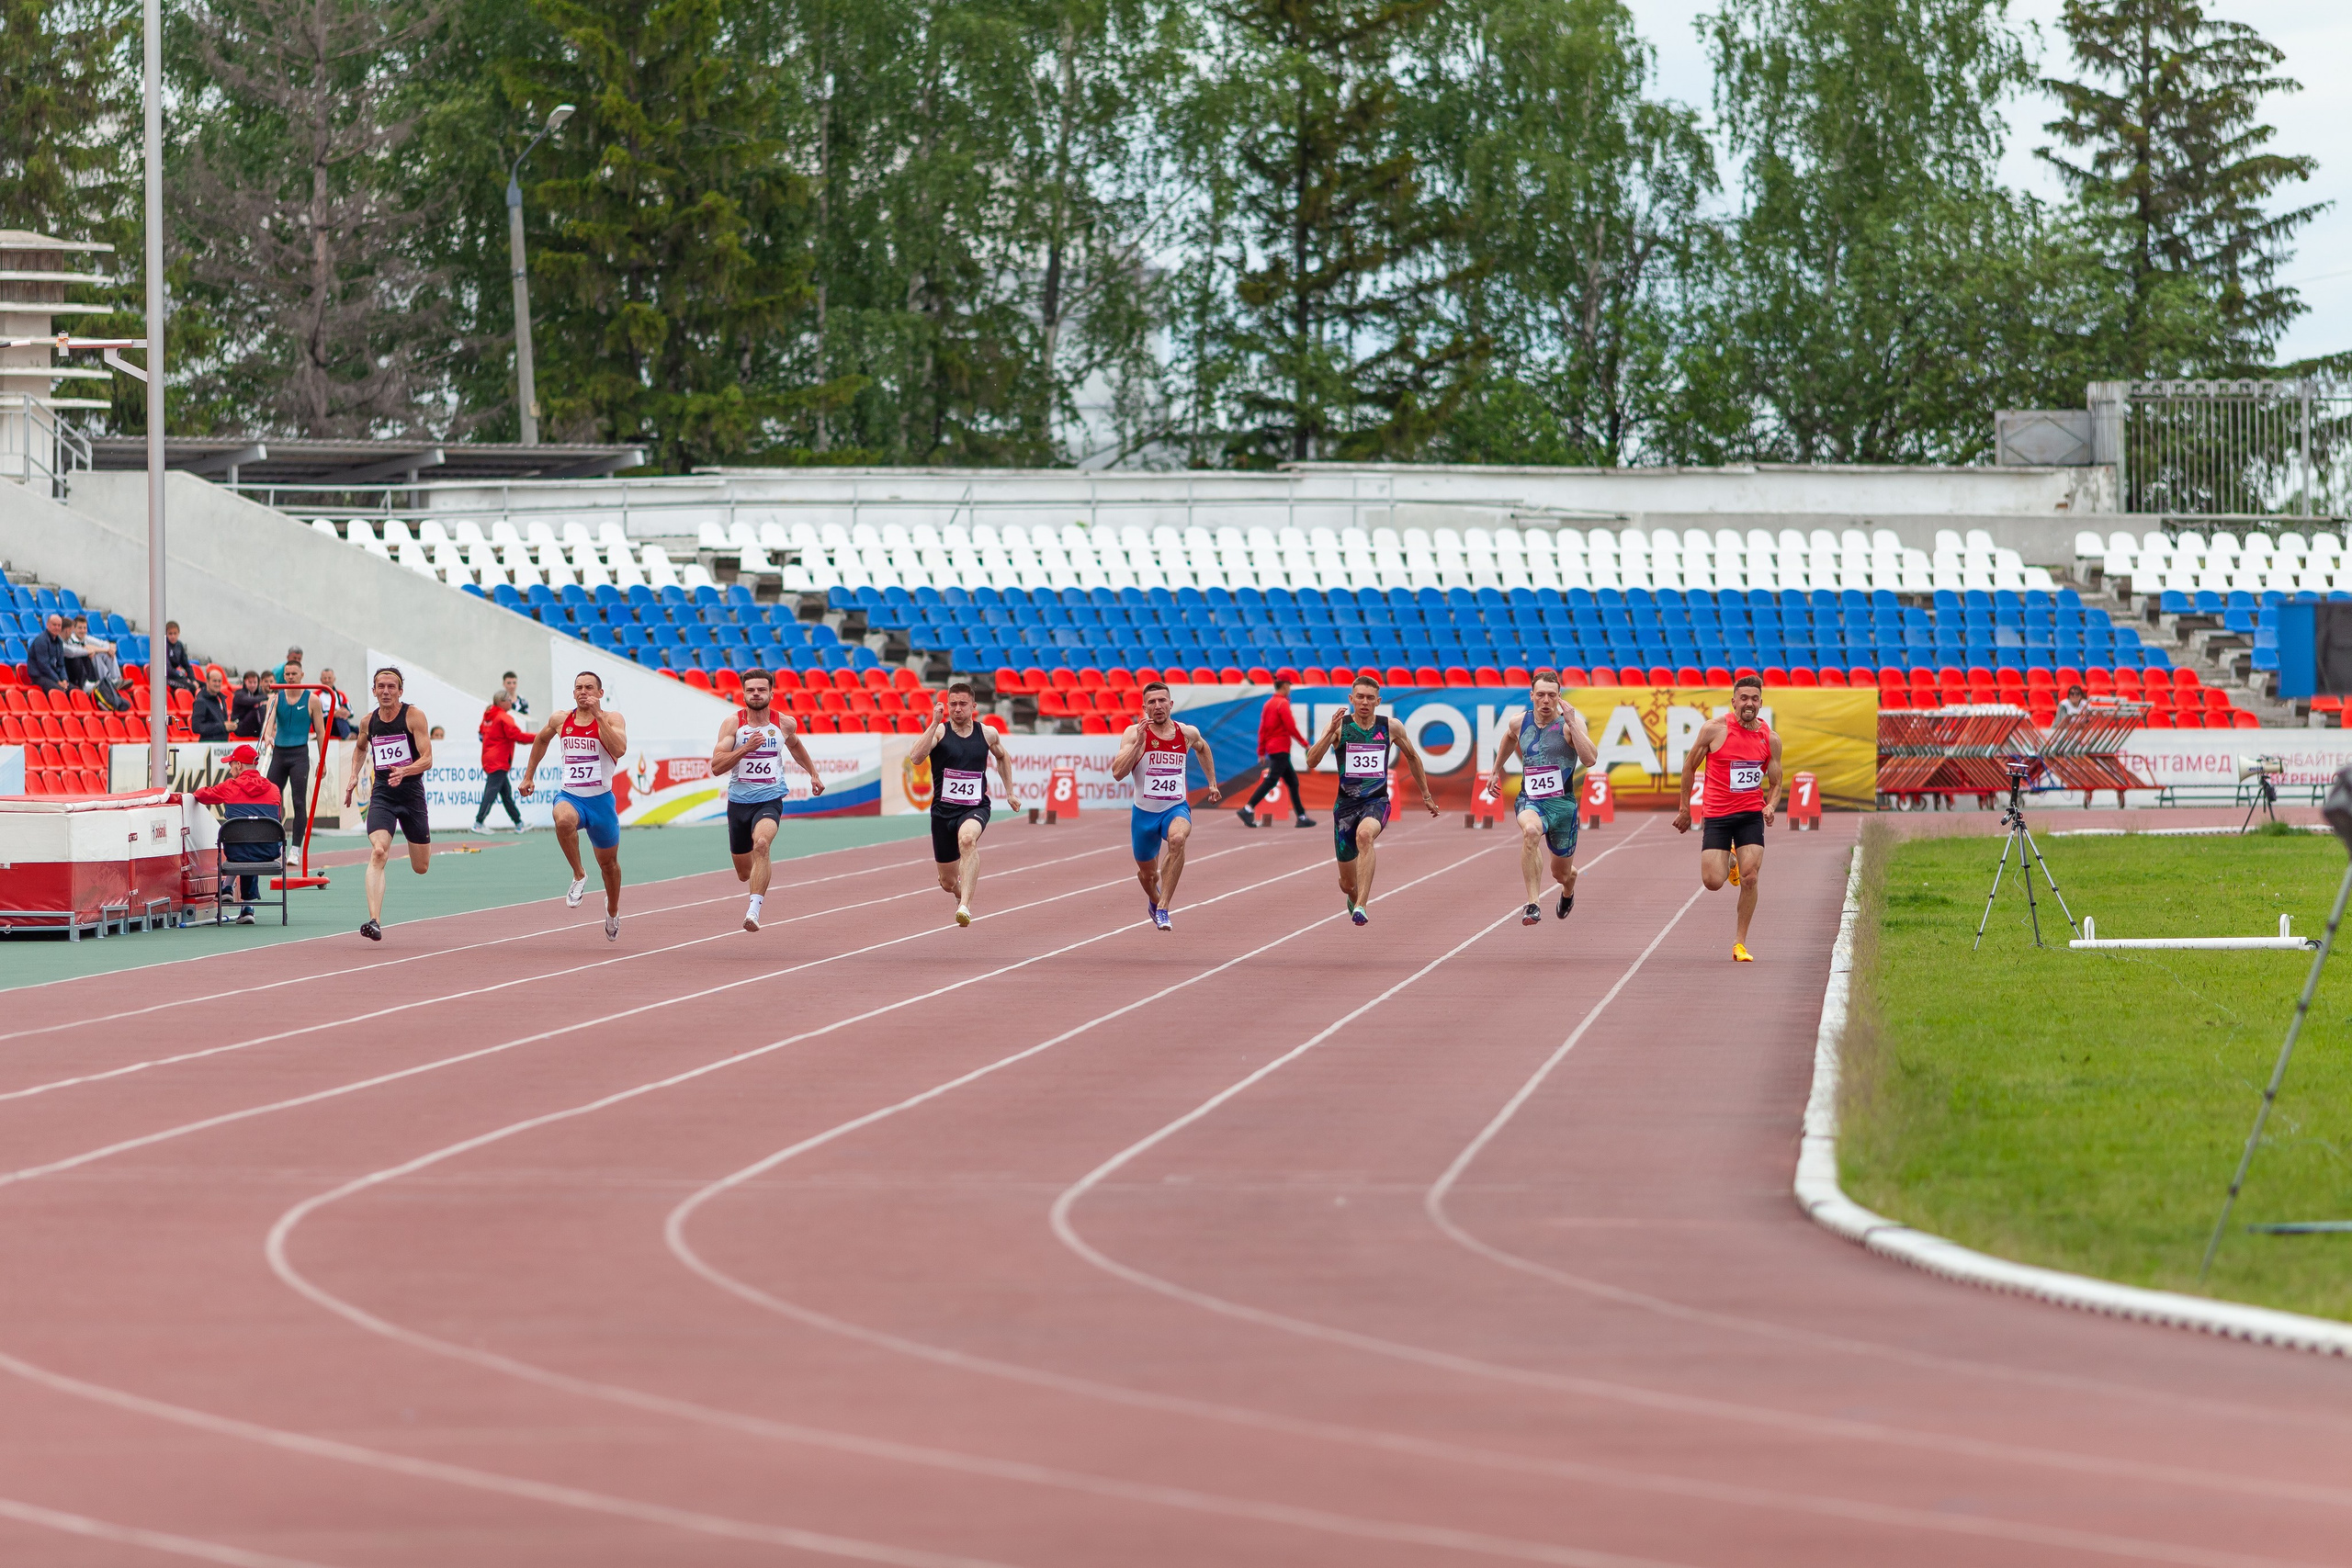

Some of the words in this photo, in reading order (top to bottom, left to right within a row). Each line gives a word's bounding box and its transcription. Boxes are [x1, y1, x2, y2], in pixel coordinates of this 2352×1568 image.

[563, 738, 595, 752] RUSSIA
[379, 747, 402, 760] 196
[1149, 753, 1183, 766] RUSSIA
[745, 761, 771, 774] 266
[1352, 756, 1378, 768] 335
[570, 766, 594, 779] 257
[1737, 772, 1760, 783] 258
[949, 782, 975, 795] 243
[1054, 777, 1072, 802] 8
[1151, 779, 1177, 792] 248
[1530, 776, 1555, 790] 245
[1589, 781, 1607, 806] 3
[1690, 781, 1704, 806] 2
[1798, 782, 1812, 807] 1
